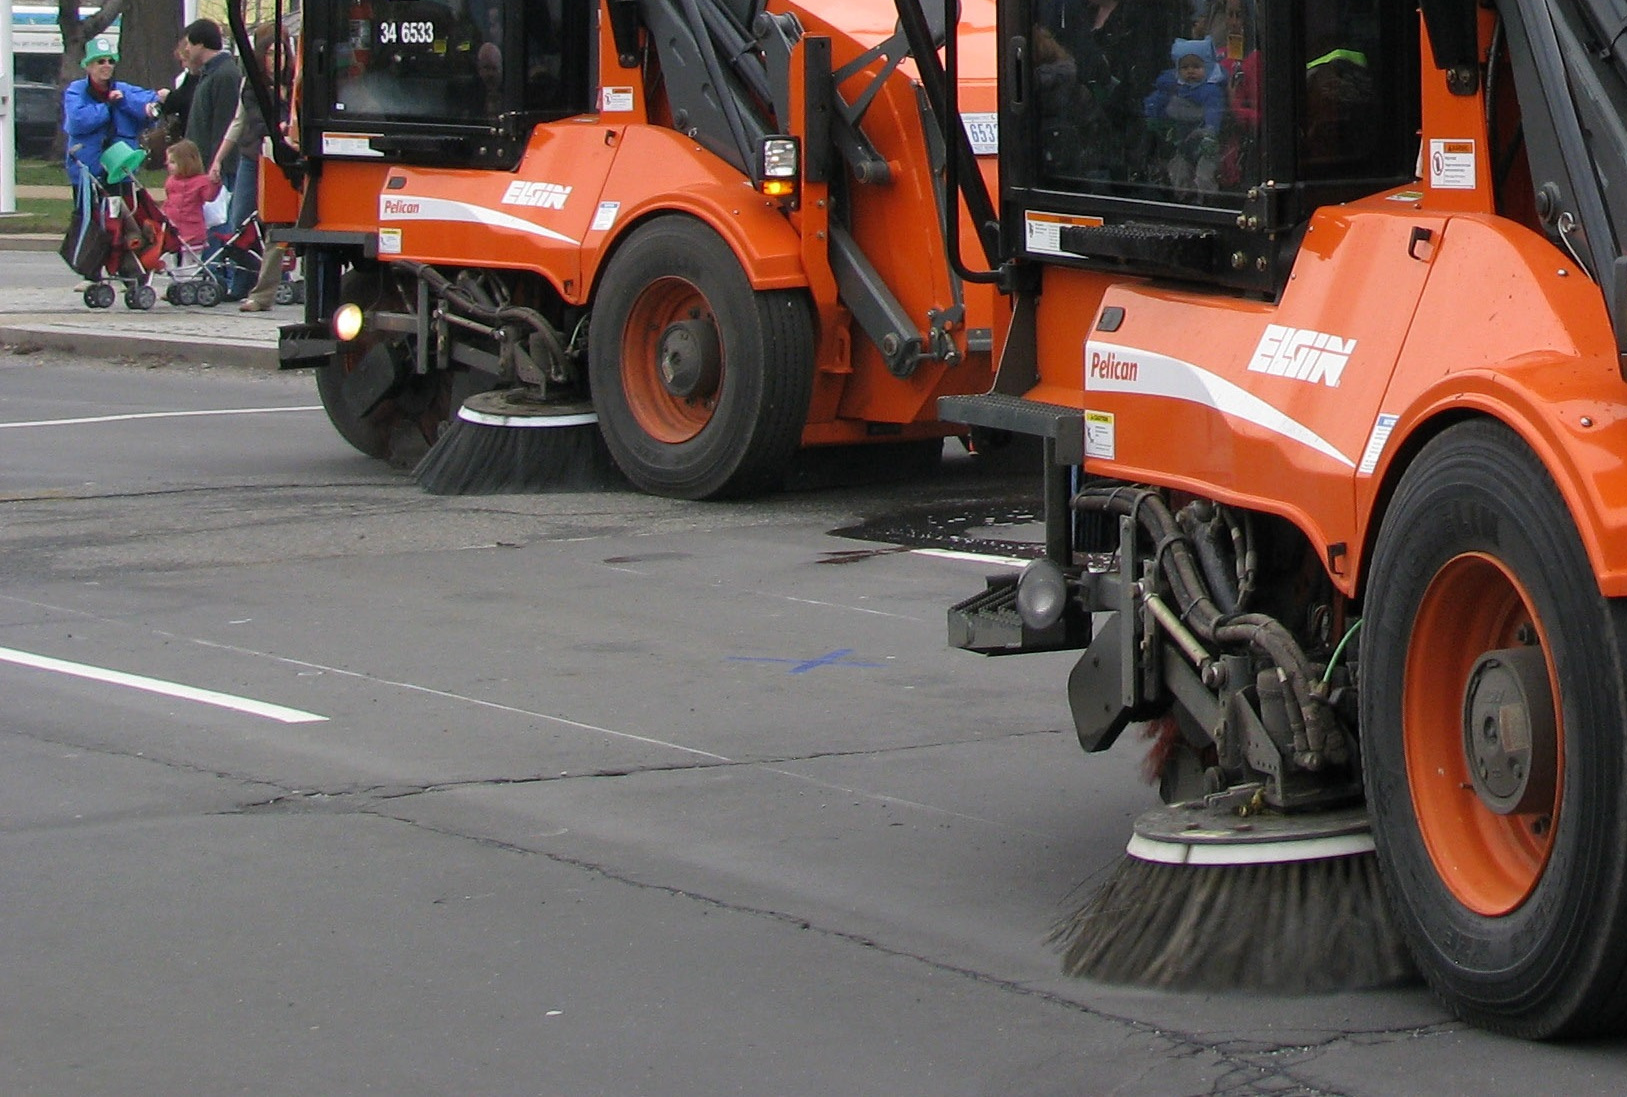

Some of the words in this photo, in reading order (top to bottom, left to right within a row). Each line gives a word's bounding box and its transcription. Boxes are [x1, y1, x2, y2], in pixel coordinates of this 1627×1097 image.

[380, 21, 397, 43] 34
[402, 21, 434, 43] 6533
[384, 200, 420, 214] Pelican
[501, 180, 573, 210] ELGIN
[1091, 352, 1138, 382] Pelican
[1247, 323, 1358, 388] ELGIN
